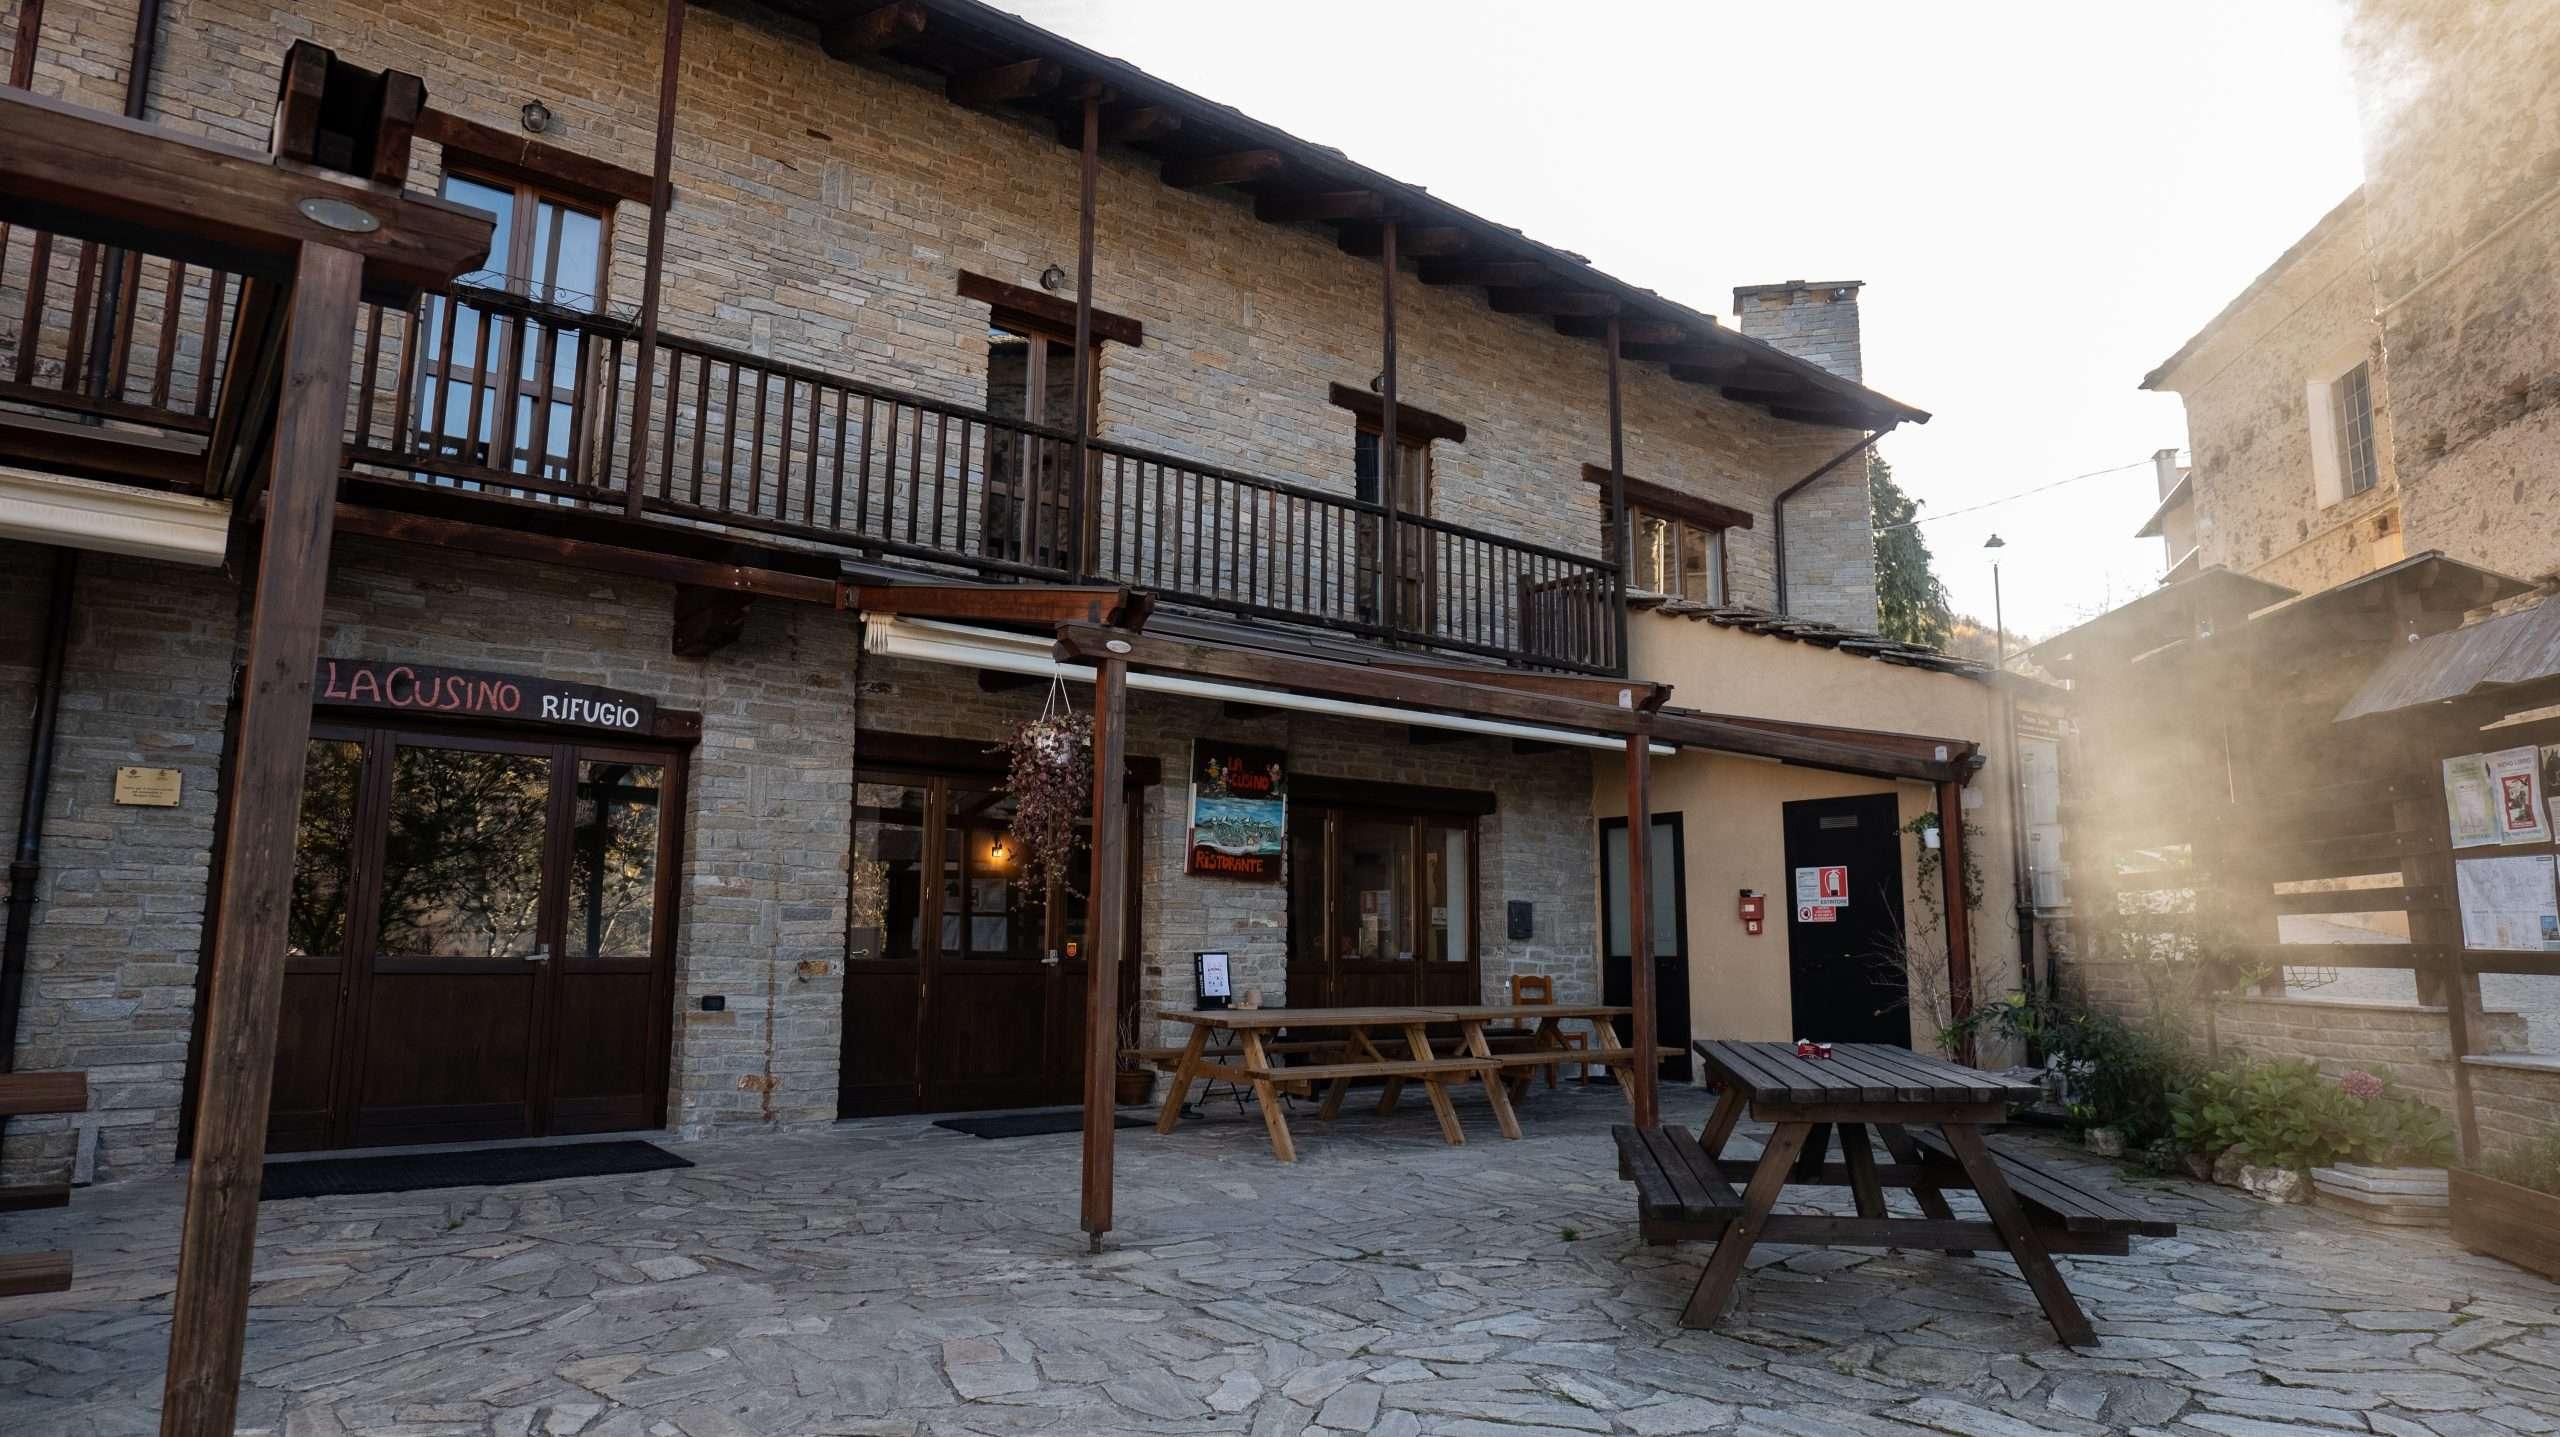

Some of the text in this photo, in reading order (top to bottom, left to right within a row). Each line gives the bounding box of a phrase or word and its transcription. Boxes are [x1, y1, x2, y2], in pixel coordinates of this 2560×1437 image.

[1227, 756, 1242, 771] LA
[1232, 773, 1271, 791] CUSINO
[1195, 850, 1264, 873] RISTORANTE
